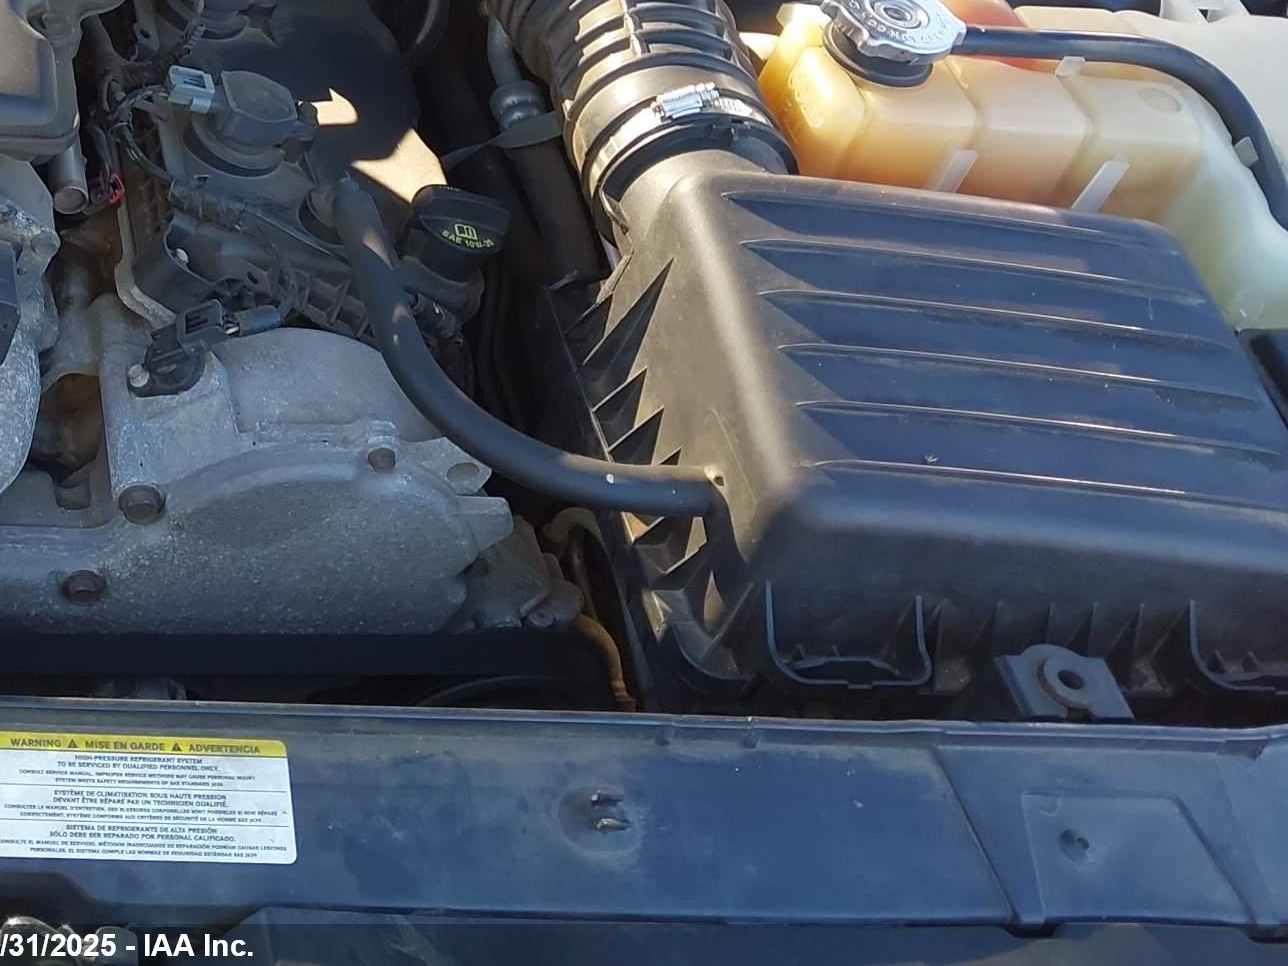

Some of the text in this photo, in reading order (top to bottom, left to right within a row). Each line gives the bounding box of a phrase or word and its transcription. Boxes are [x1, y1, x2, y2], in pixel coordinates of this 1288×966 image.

[9, 737, 61, 747] WARNING
[84, 740, 165, 751] MISE EN GARDE
[187, 743, 260, 754] ADVERTENCIA
